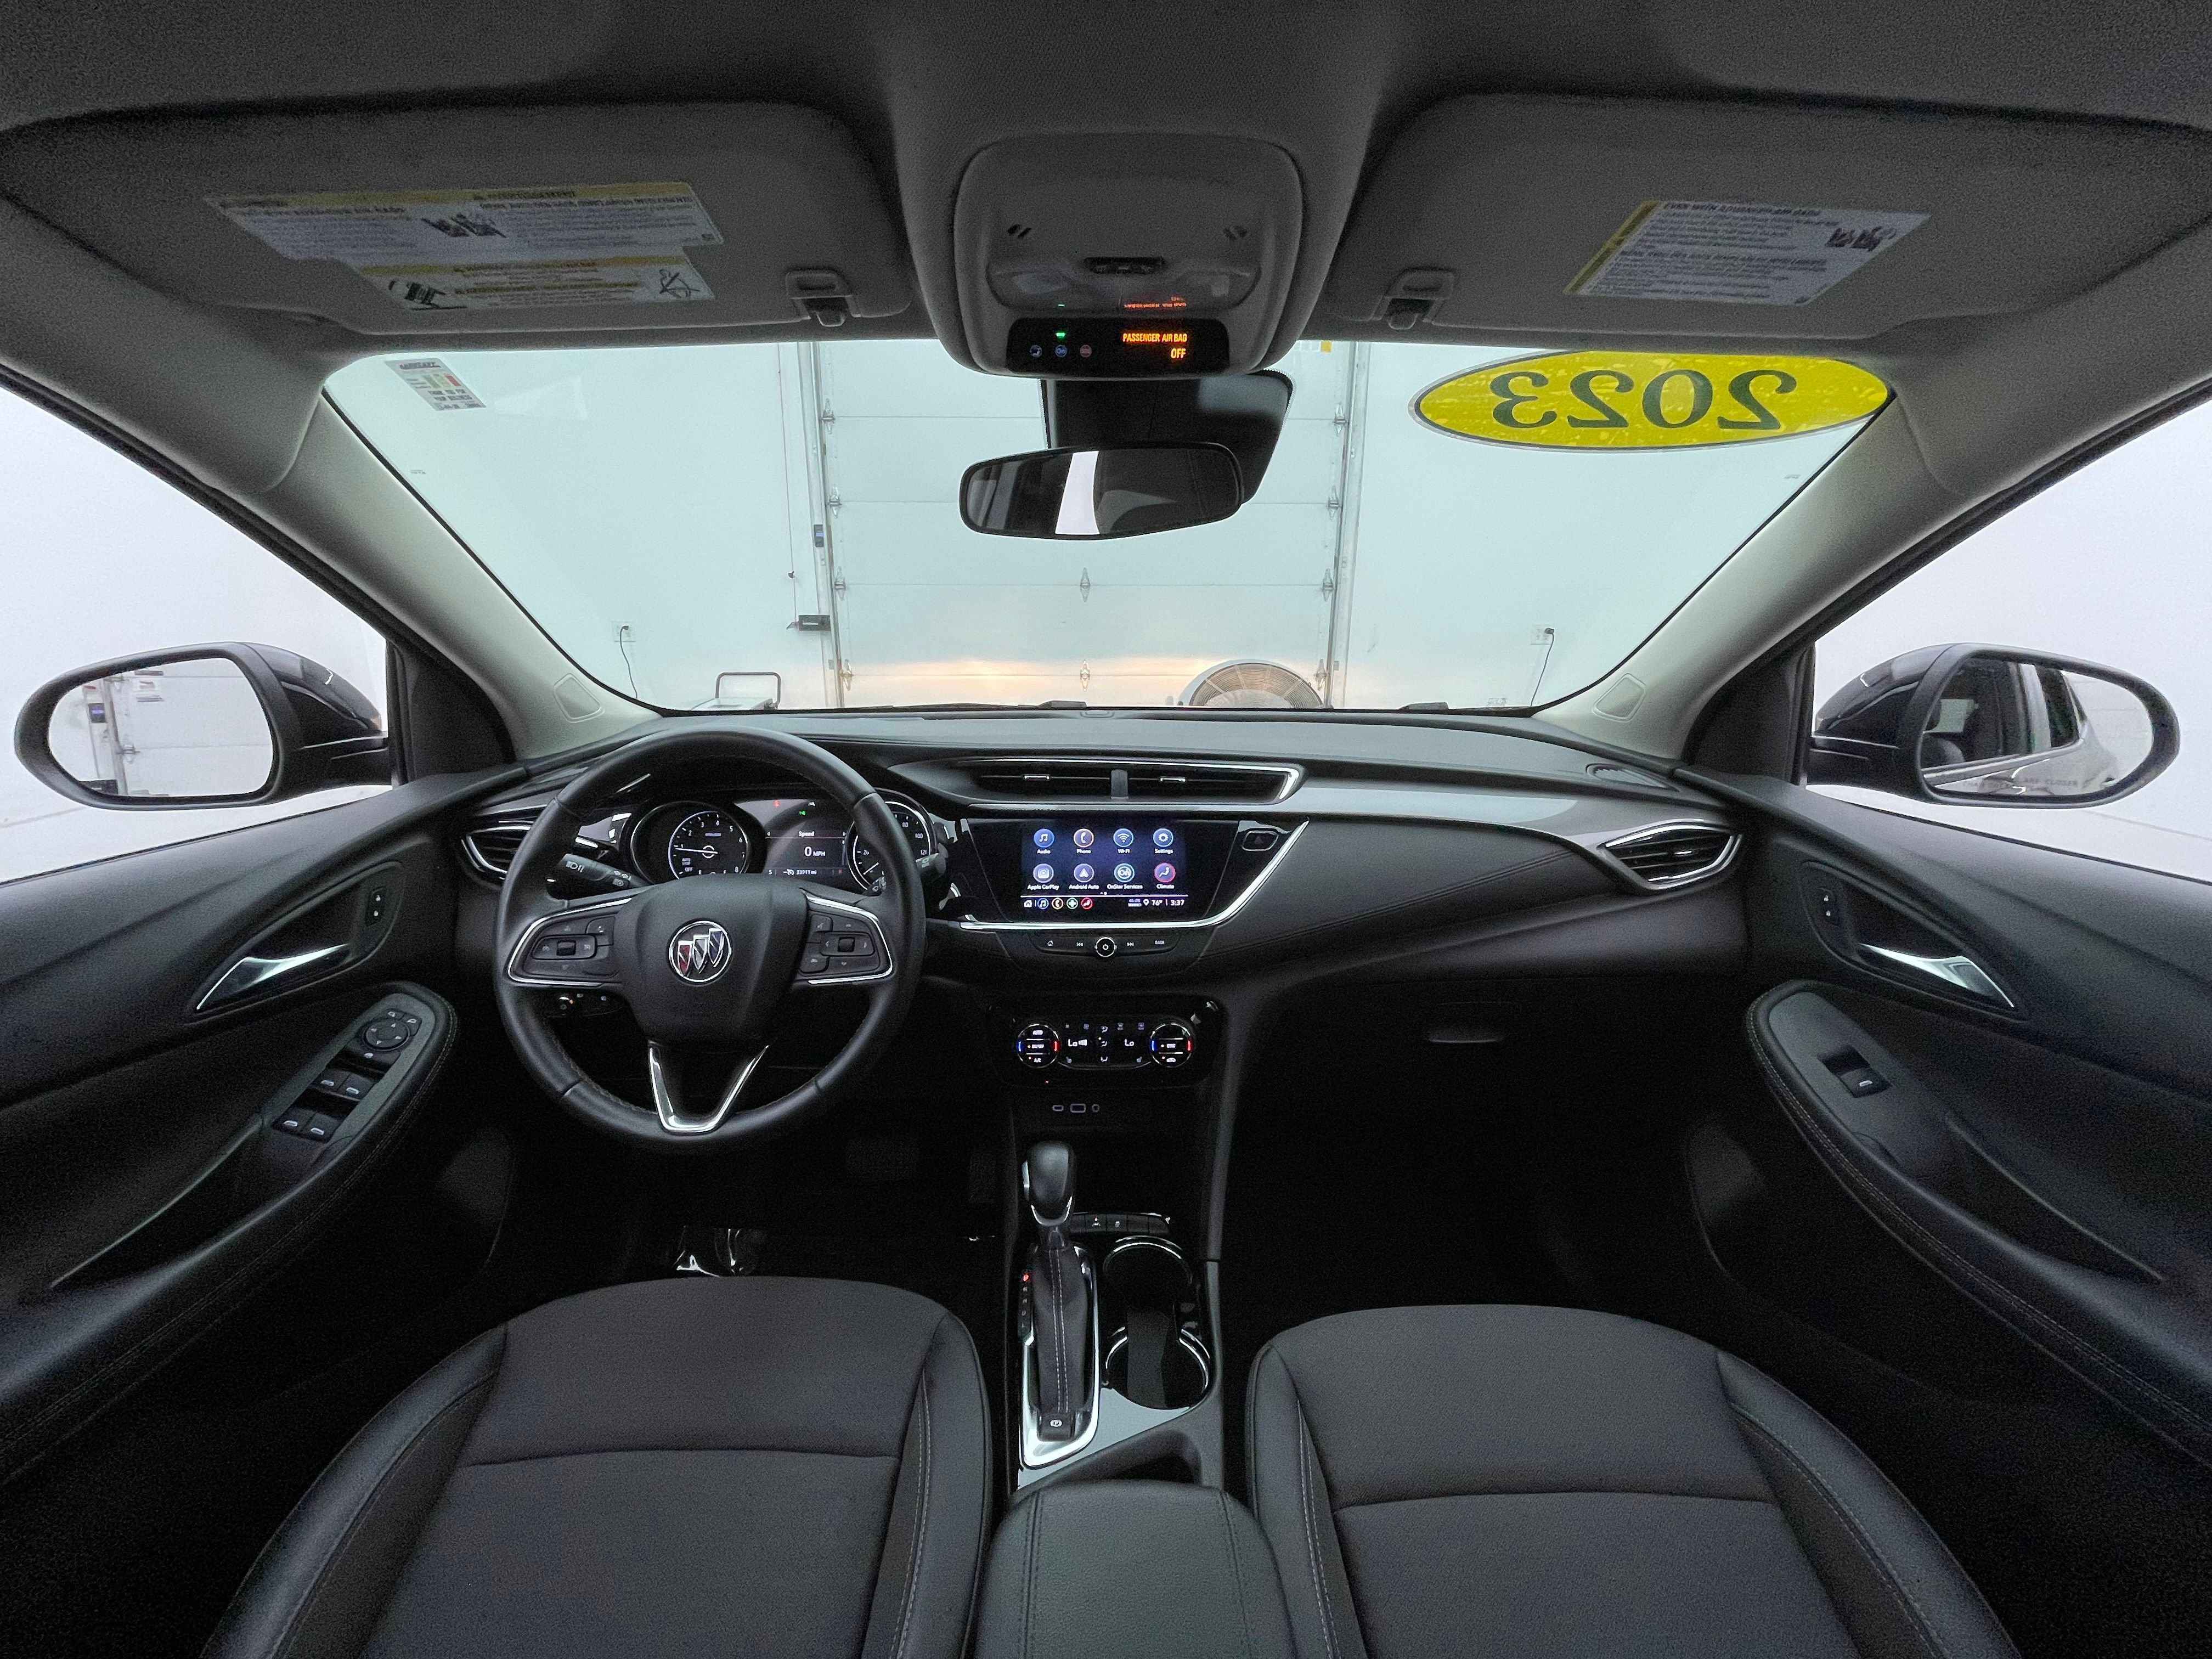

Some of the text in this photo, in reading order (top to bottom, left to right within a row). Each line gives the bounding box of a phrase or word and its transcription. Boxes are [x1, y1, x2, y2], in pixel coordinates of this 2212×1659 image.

[1122, 333, 1187, 342] PASSENGER AIR BAG
[1171, 348, 1186, 358] OFF
[804, 846, 812, 857] 0
[1068, 1039, 1078, 1047] Lo
